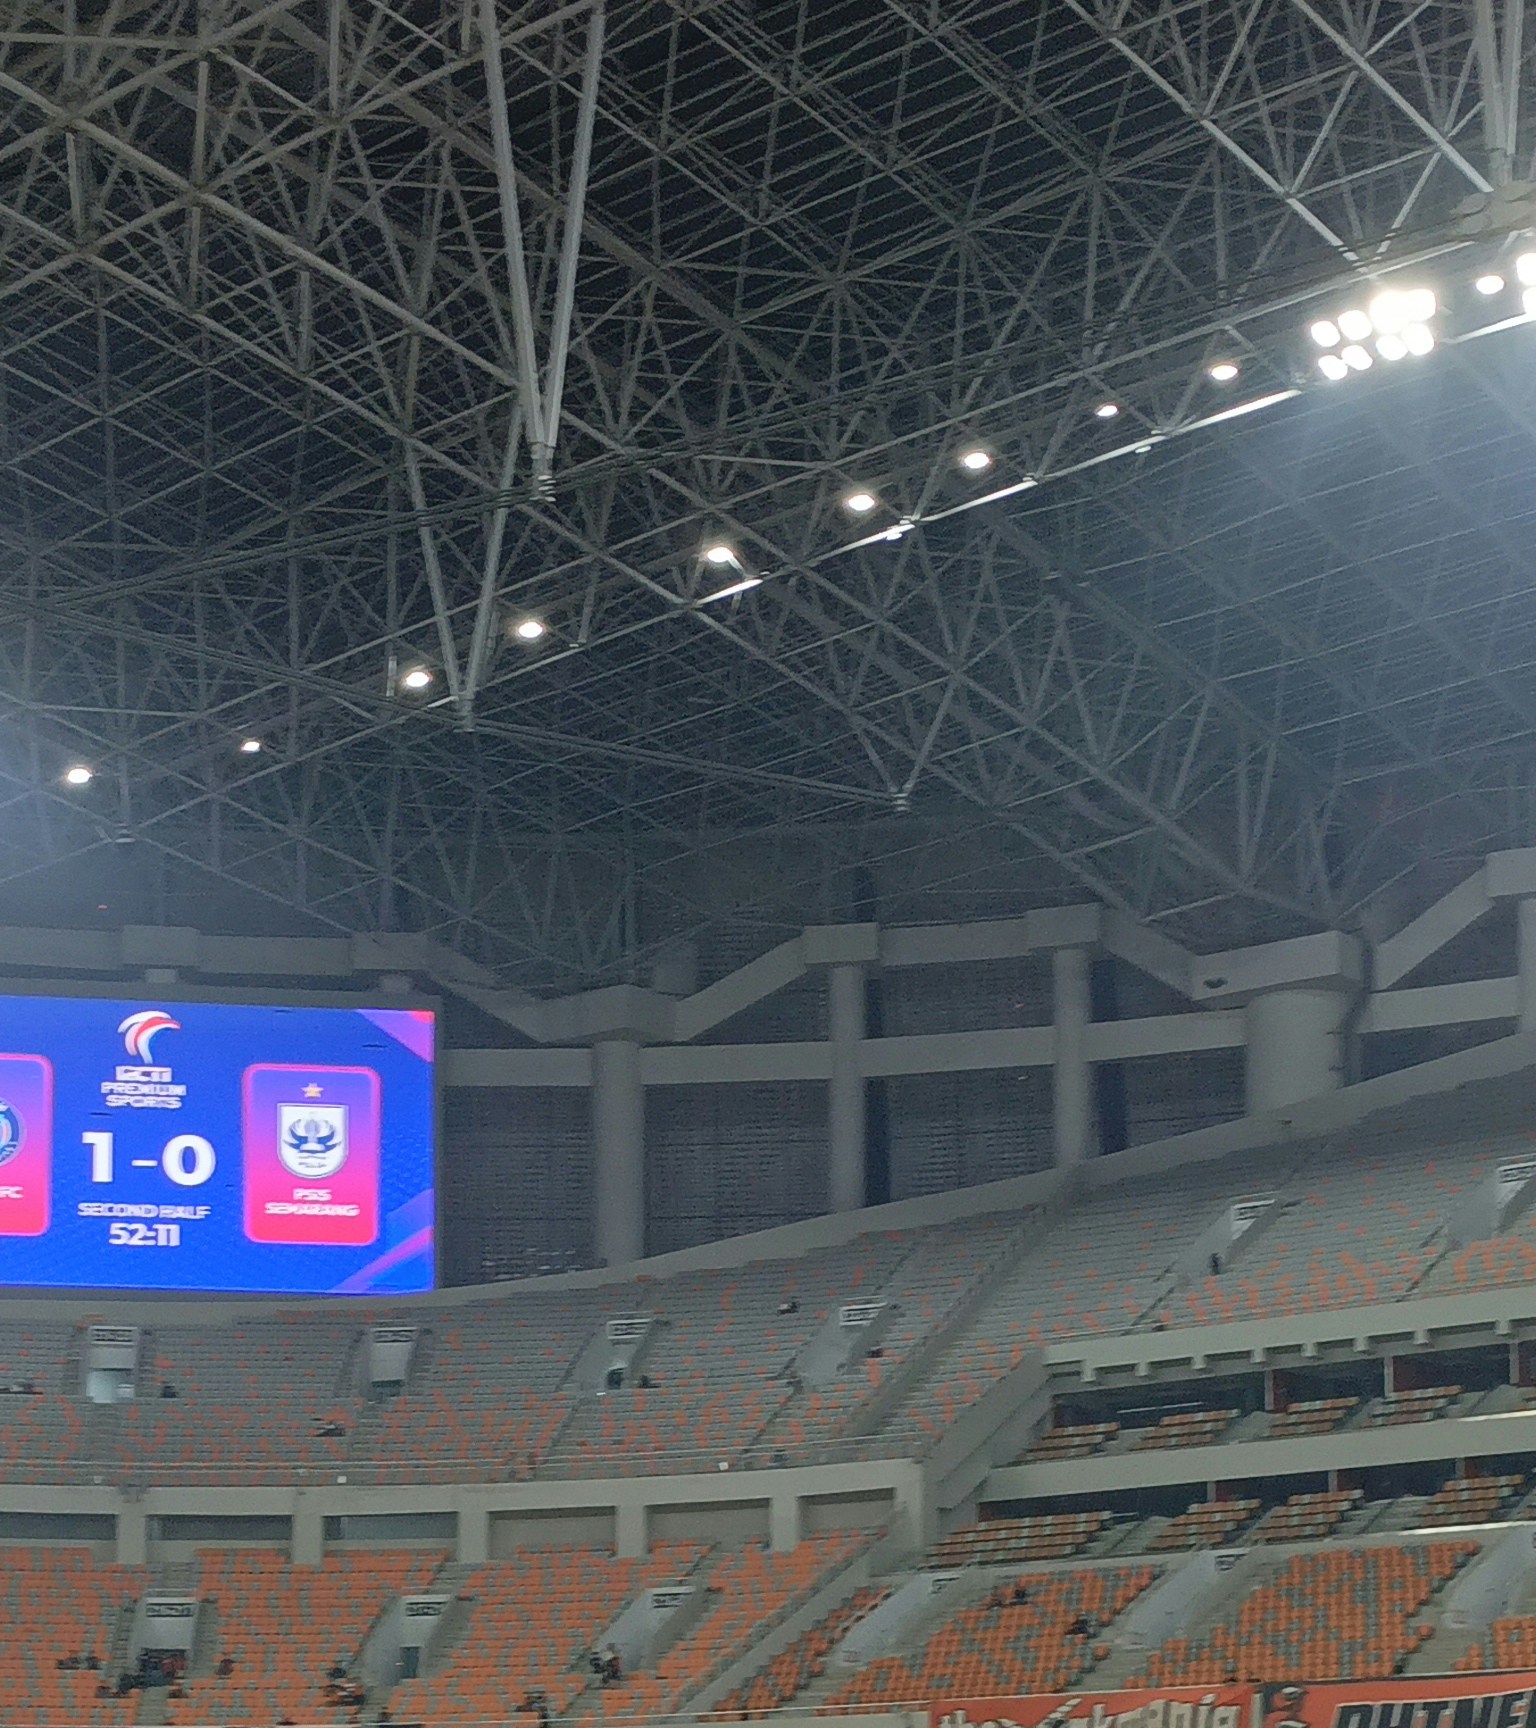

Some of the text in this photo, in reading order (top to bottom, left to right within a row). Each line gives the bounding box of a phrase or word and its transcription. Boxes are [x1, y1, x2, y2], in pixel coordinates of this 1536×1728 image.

[77, 1202, 212, 1220] SECOND HALF
[108, 1222, 181, 1247] 52:11
